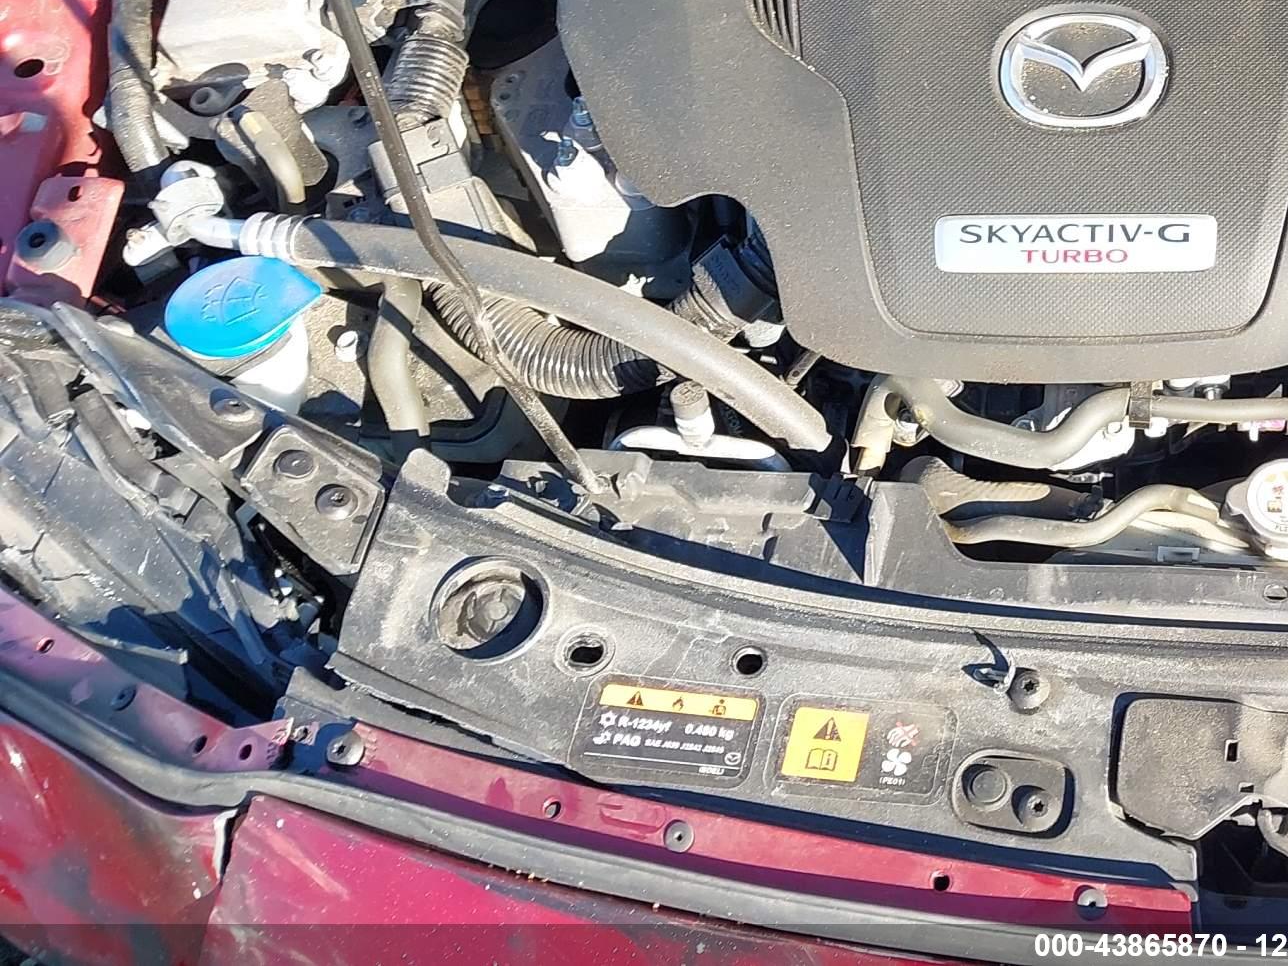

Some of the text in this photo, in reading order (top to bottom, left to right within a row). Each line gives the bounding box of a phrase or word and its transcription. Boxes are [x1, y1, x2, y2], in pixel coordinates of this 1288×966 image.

[959, 223, 1191, 244] SKYACTIV-G
[1020, 249, 1129, 264] TURBO
[618, 715, 672, 733] R-1234yf
[717, 726, 735, 741] kg
[612, 733, 641, 747] PAG
